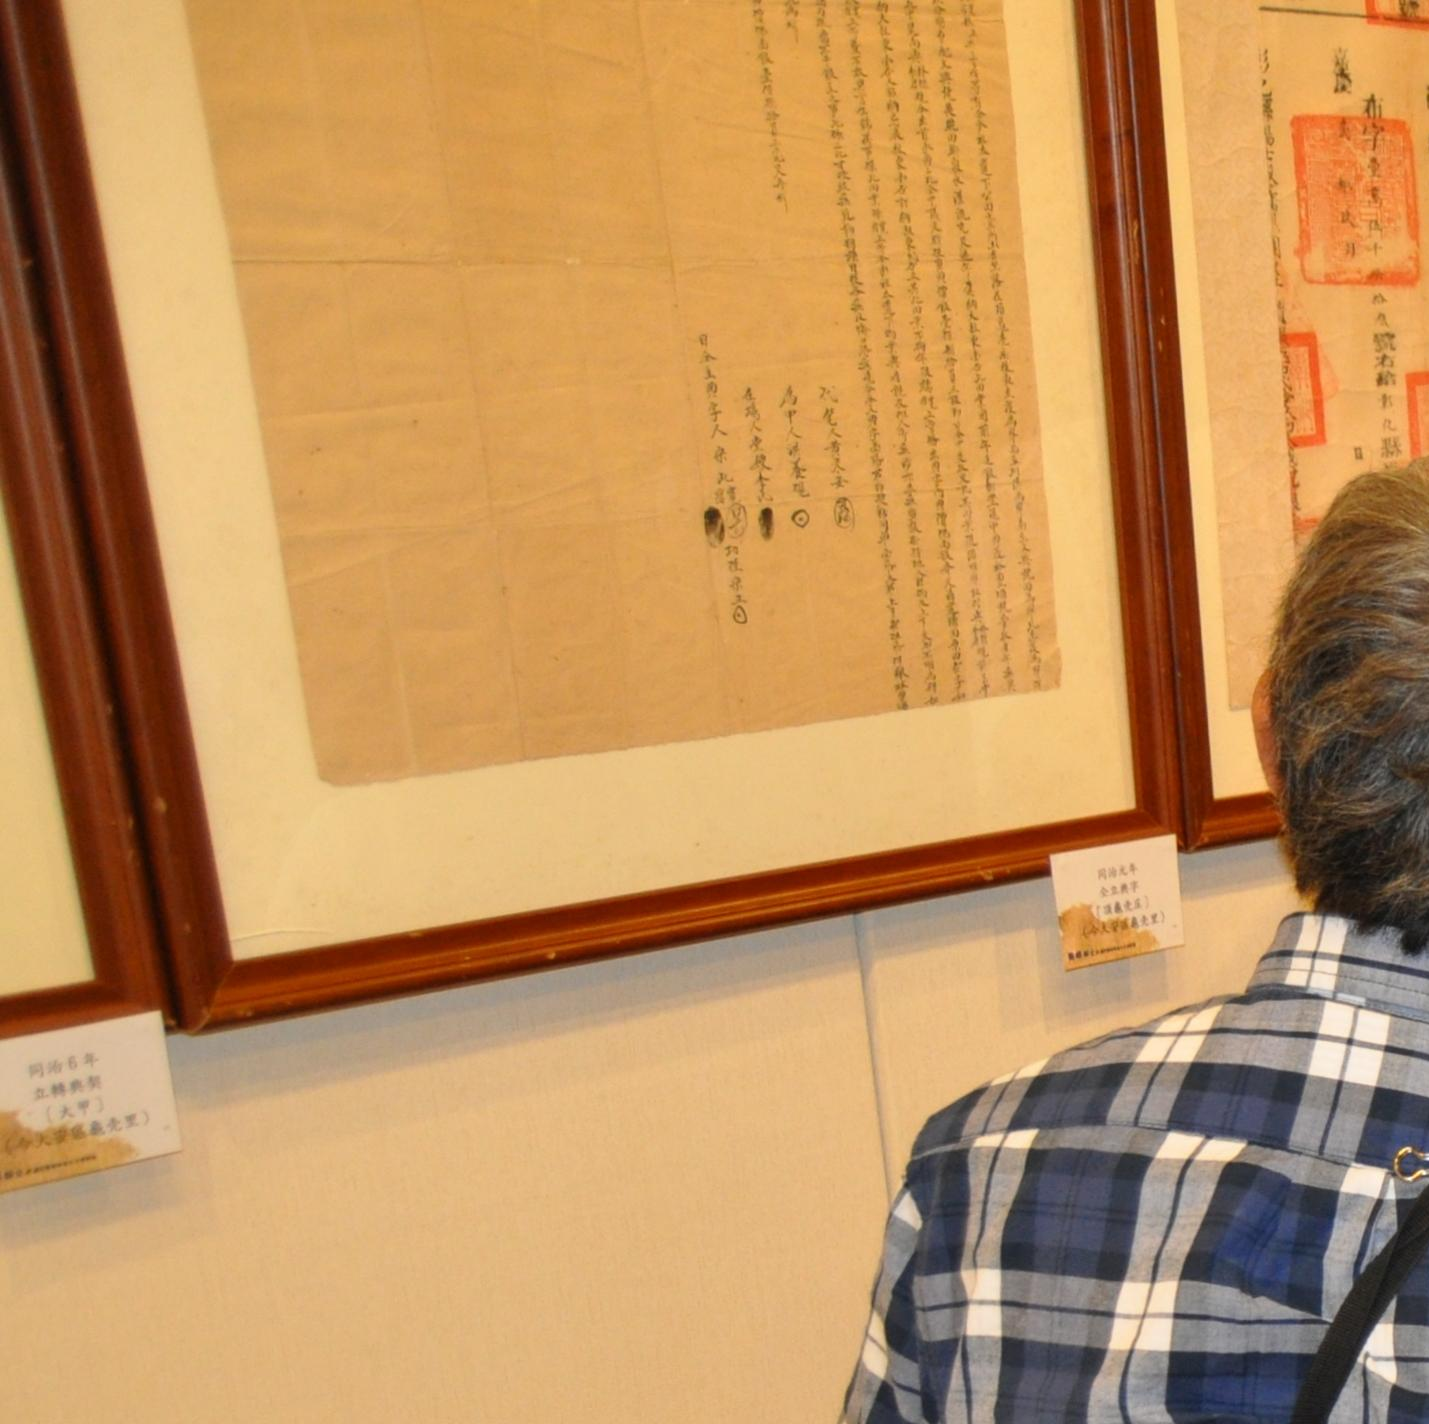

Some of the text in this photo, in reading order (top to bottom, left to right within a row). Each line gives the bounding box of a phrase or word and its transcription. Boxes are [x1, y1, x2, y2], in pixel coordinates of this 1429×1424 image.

[28, 1052, 99, 1079] 同治6年
[46, 1096, 104, 1123] (大甲)
